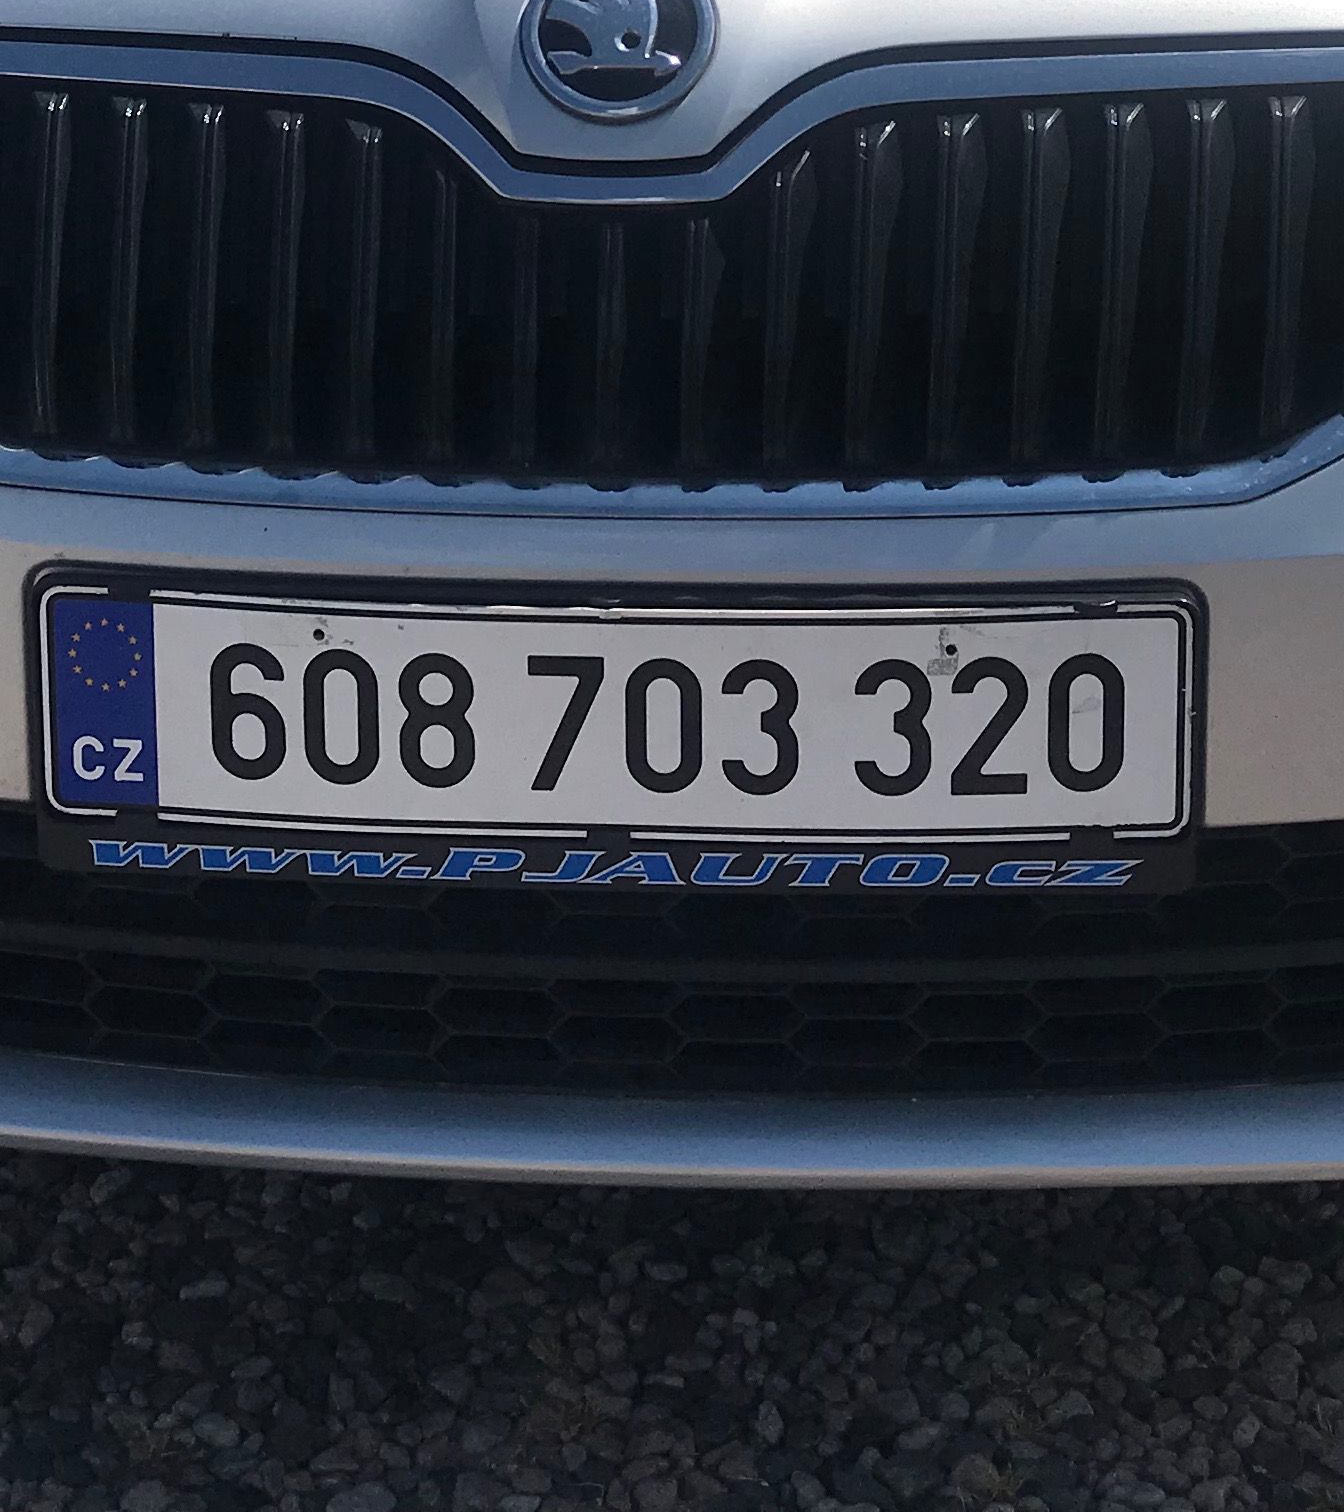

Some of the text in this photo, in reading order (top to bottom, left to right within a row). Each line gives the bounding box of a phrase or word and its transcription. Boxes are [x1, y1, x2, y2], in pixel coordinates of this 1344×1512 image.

[73, 735, 144, 782] CZ
[208, 642, 1127, 797] 608 703 320
